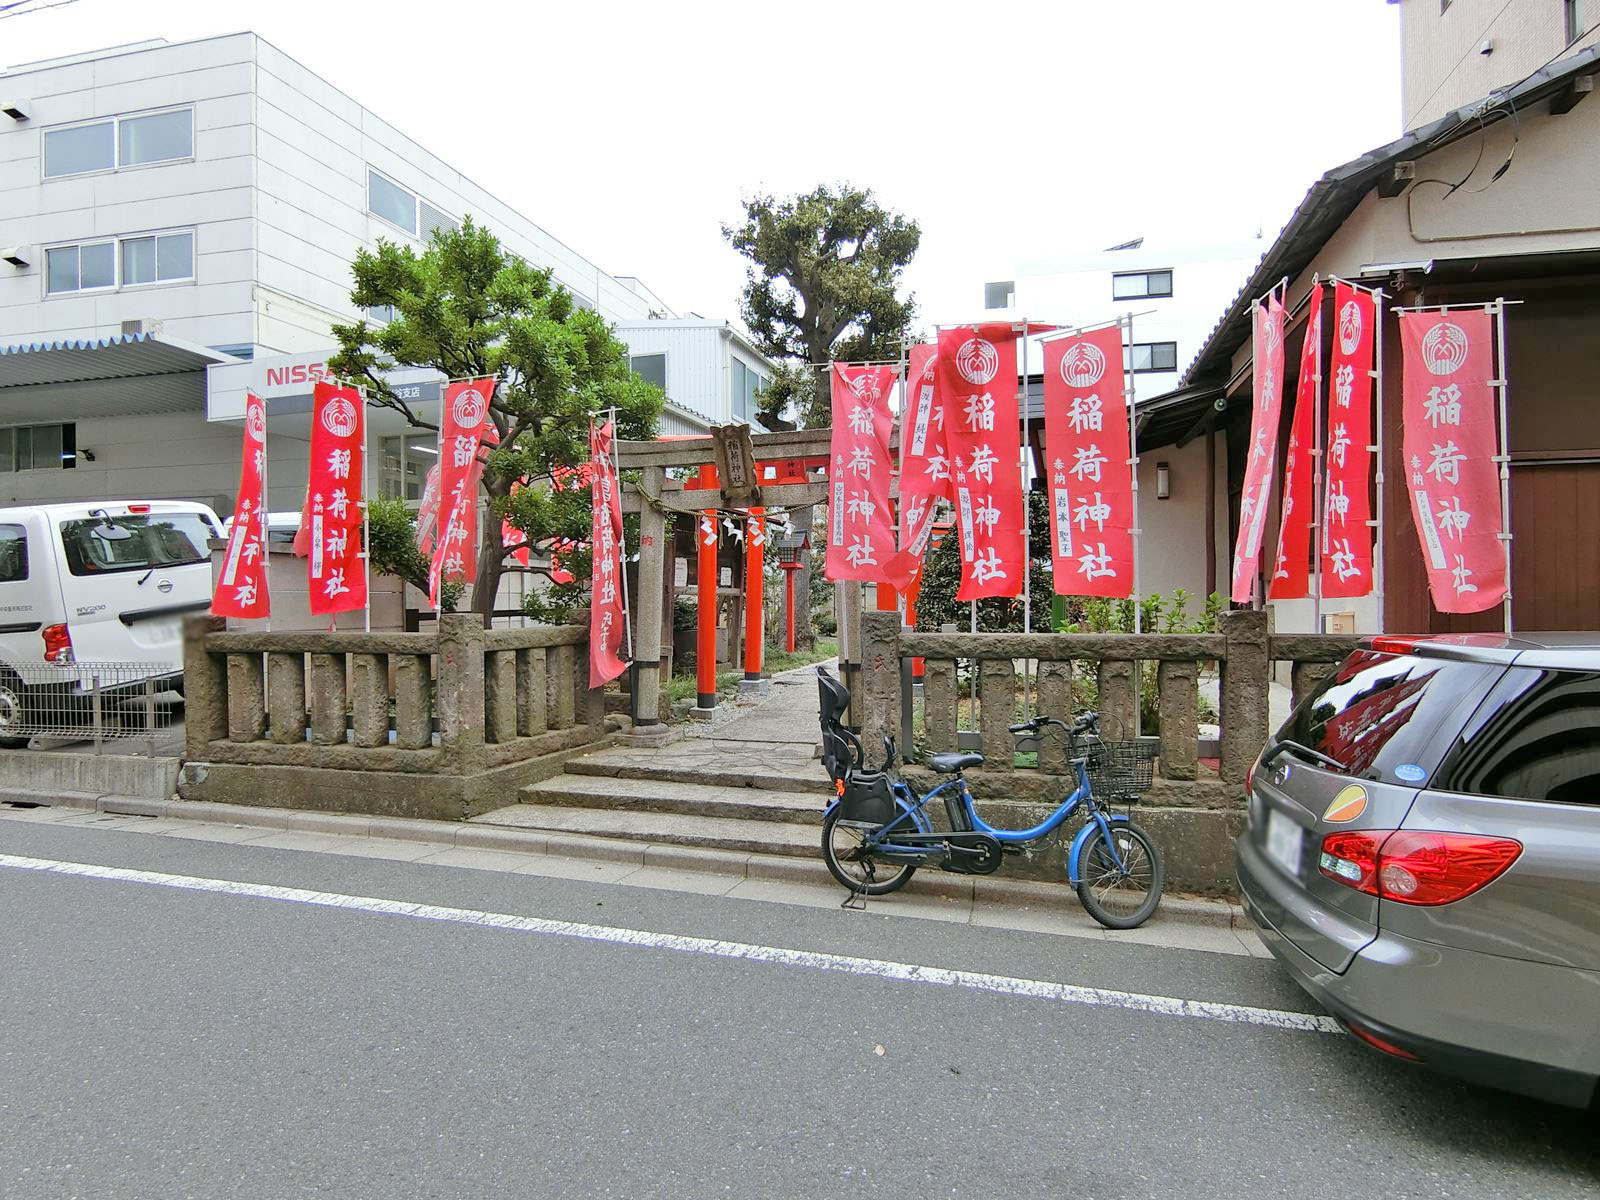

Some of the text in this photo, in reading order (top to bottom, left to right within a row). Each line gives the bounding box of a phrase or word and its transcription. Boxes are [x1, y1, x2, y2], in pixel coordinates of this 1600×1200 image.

[392, 386, 421, 399] 谷支店
[1053, 457, 1066, 485] 奉納
[1328, 363, 1362, 584] 稲荷神社
[1410, 454, 1424, 486] 奉納
[322, 448, 352, 600] 稲荷神社
[846, 405, 877, 569] 稲荷神社
[962, 392, 1008, 586] 稲荷神社
[1066, 393, 1117, 582] 稲荷神社
[1423, 383, 1478, 598] 稲荷神社
